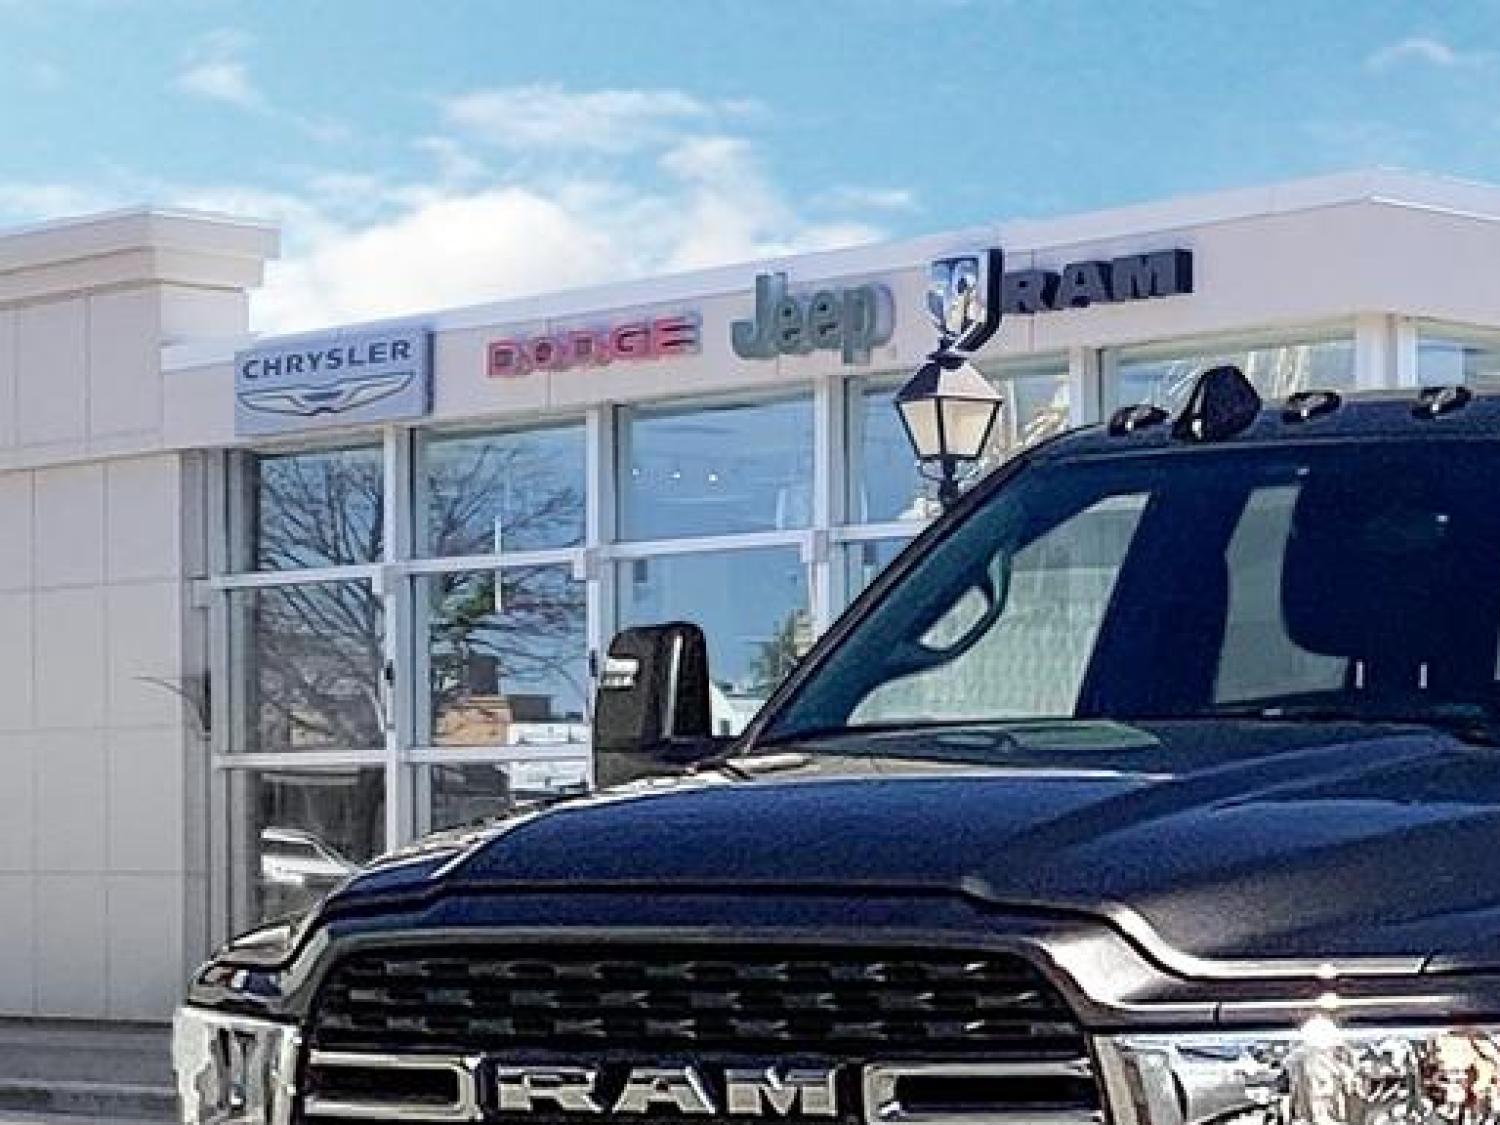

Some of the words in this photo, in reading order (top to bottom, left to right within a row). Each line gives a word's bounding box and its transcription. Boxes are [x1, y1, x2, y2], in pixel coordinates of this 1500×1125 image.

[1002, 249, 1193, 314] RAM
[485, 314, 698, 377] DODGE
[731, 271, 895, 365] Jeep
[242, 338, 411, 379] CHRYSLER
[498, 1066, 837, 1116] RAM
